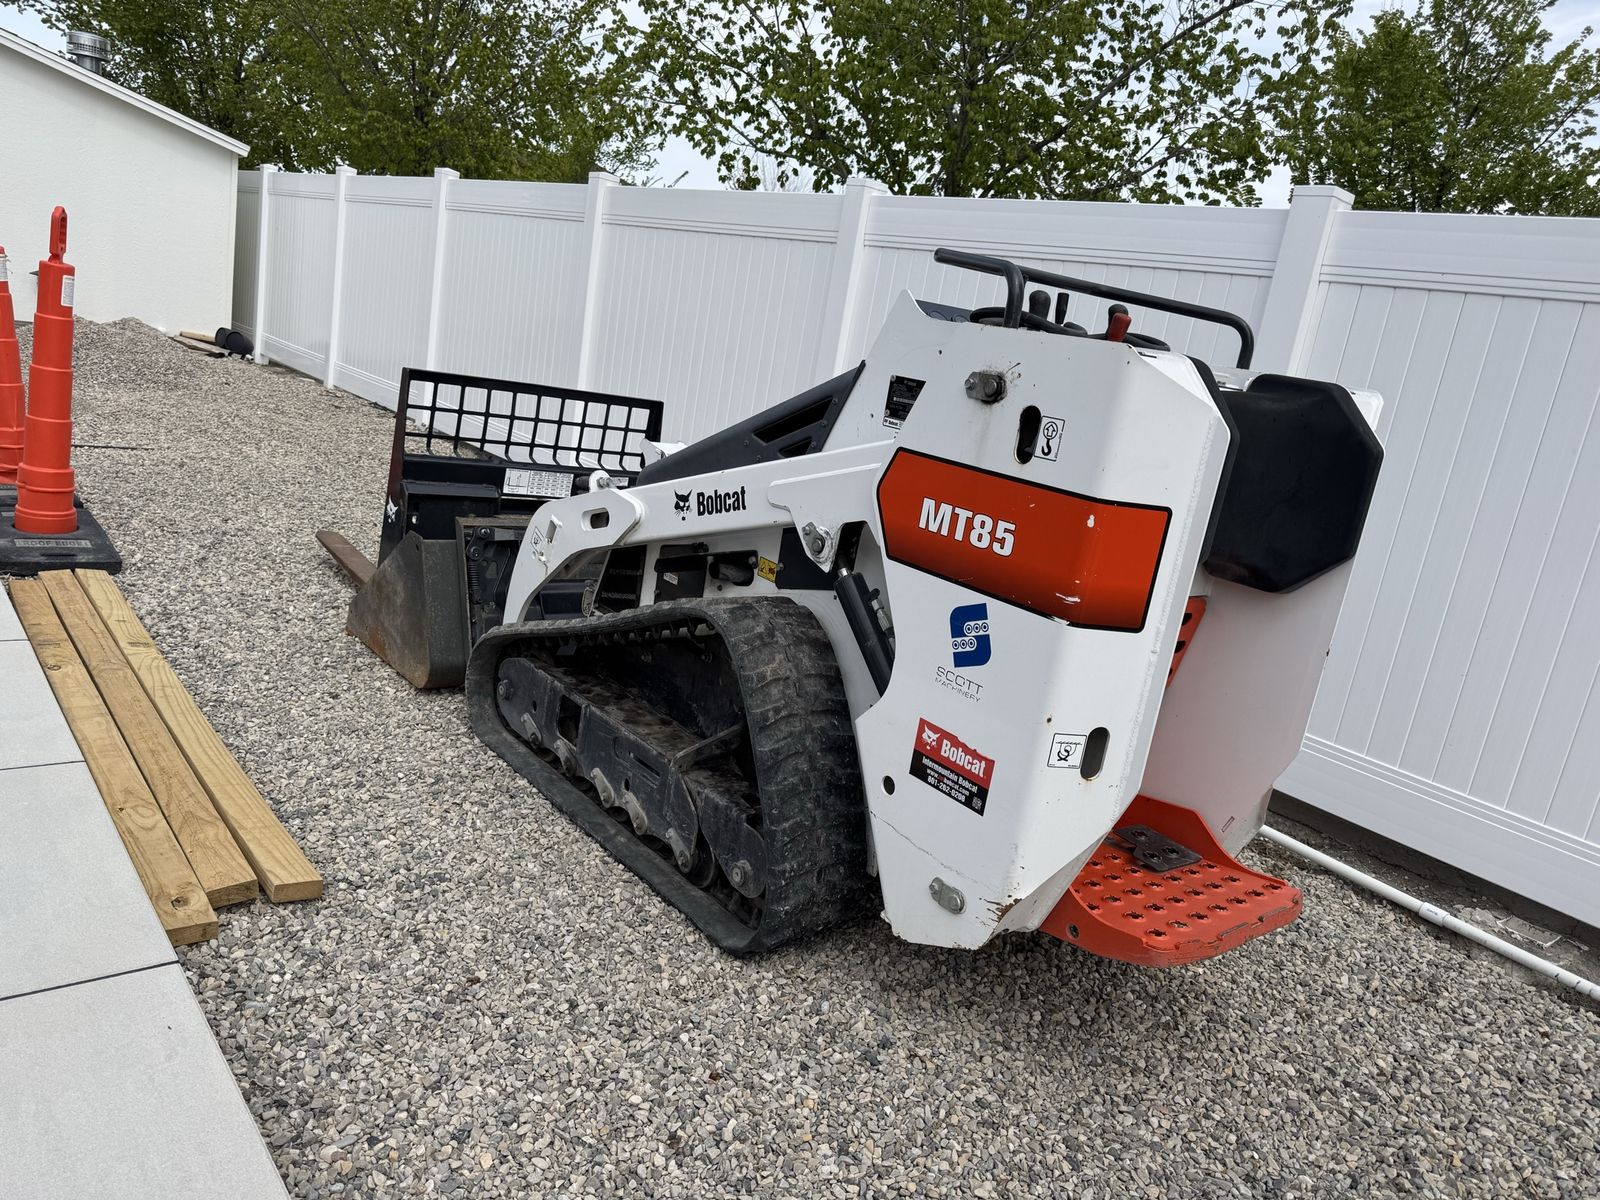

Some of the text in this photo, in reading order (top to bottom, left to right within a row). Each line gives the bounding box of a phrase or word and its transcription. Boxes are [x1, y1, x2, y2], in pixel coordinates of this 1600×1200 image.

[697, 486, 746, 516] Bobcat
[918, 497, 1016, 557] MT85
[934, 677, 981, 702] MACHINERY
[936, 666, 983, 694] SCOTT
[940, 738, 986, 778] Bobcat
[922, 756, 978, 794] Intermountain Bobcat
[926, 768, 970, 797] www.bobcat.com
